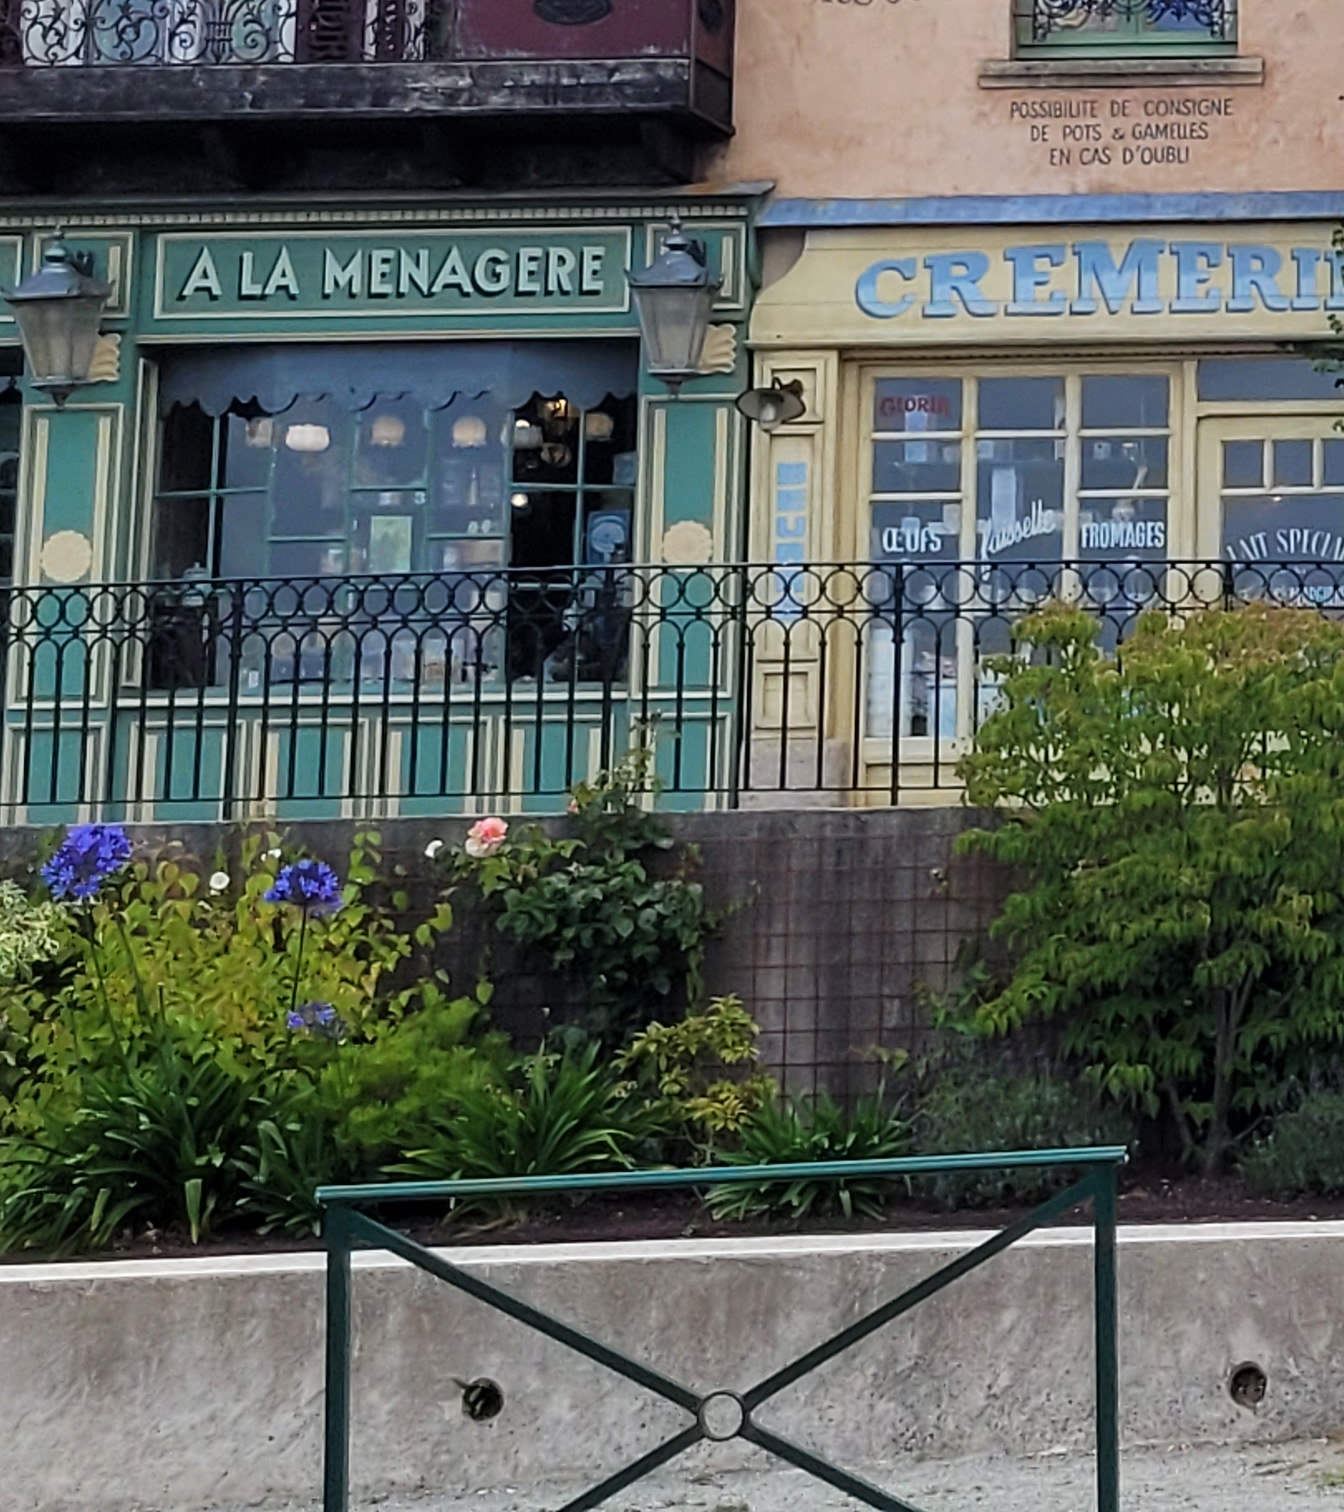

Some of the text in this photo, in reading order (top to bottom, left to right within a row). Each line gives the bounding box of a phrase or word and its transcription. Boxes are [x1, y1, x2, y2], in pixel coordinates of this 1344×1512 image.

[1010, 97, 1235, 119] POSSIBILITE DE CONSIGNE
[1030, 121, 1210, 142] DE POTS & GAMELLES
[1050, 144, 1190, 166] EN CAS D'OUBLI
[180, 244, 606, 301] A LA MENAGERE
[1081, 521, 1165, 549] FROMAGES
